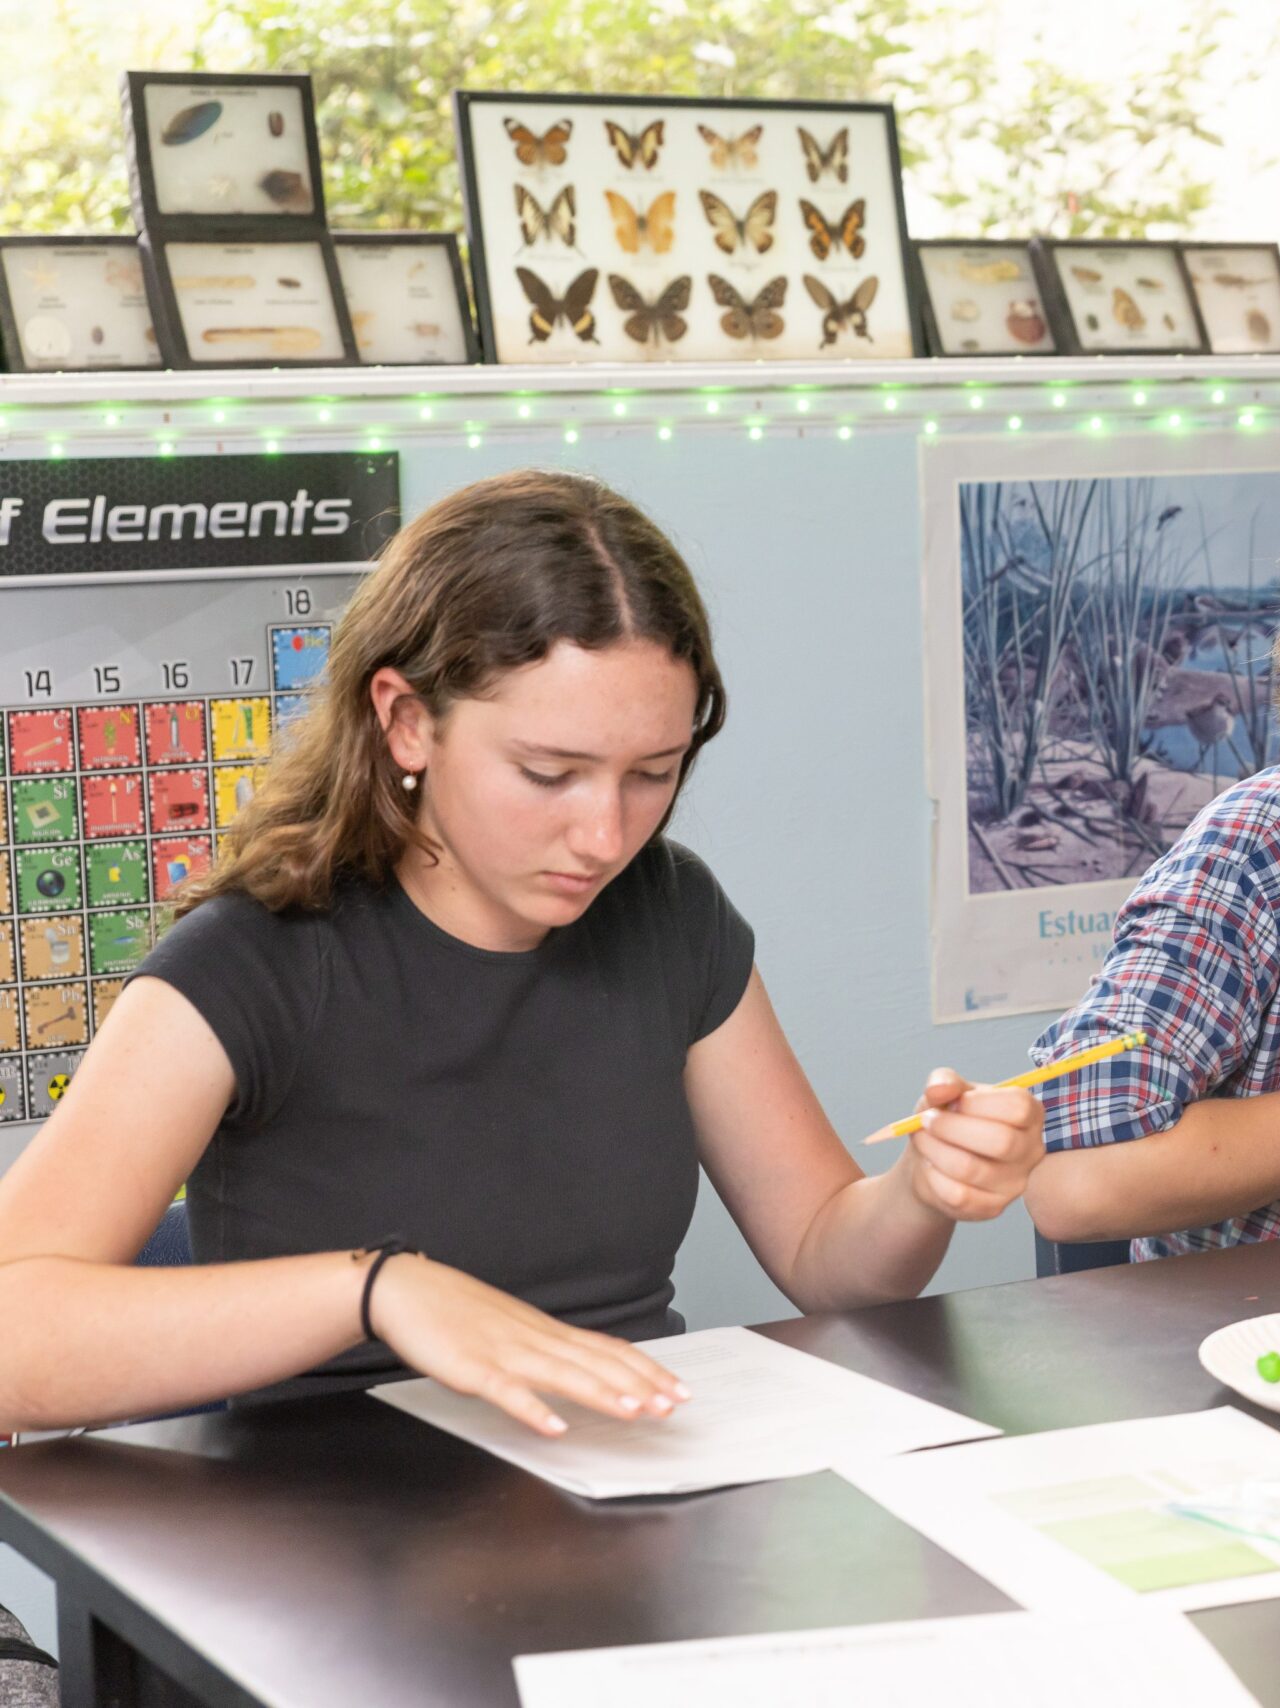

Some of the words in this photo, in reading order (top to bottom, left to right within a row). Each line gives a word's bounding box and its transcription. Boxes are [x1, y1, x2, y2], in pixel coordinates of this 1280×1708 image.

[42, 489, 353, 545] Elements
[286, 589, 311, 616] 18
[94, 666, 120, 694] 15
[162, 664, 189, 689] 16
[230, 659, 254, 686] 17
[25, 669, 52, 698] 14
[53, 715, 65, 730] C
[126, 779, 136, 795] P
[192, 775, 202, 791] S
[53, 784, 68, 800] Si
[51, 852, 73, 868] Ge
[121, 847, 141, 862] As
[126, 915, 145, 930] Sb
[61, 989, 82, 1004] Pb
